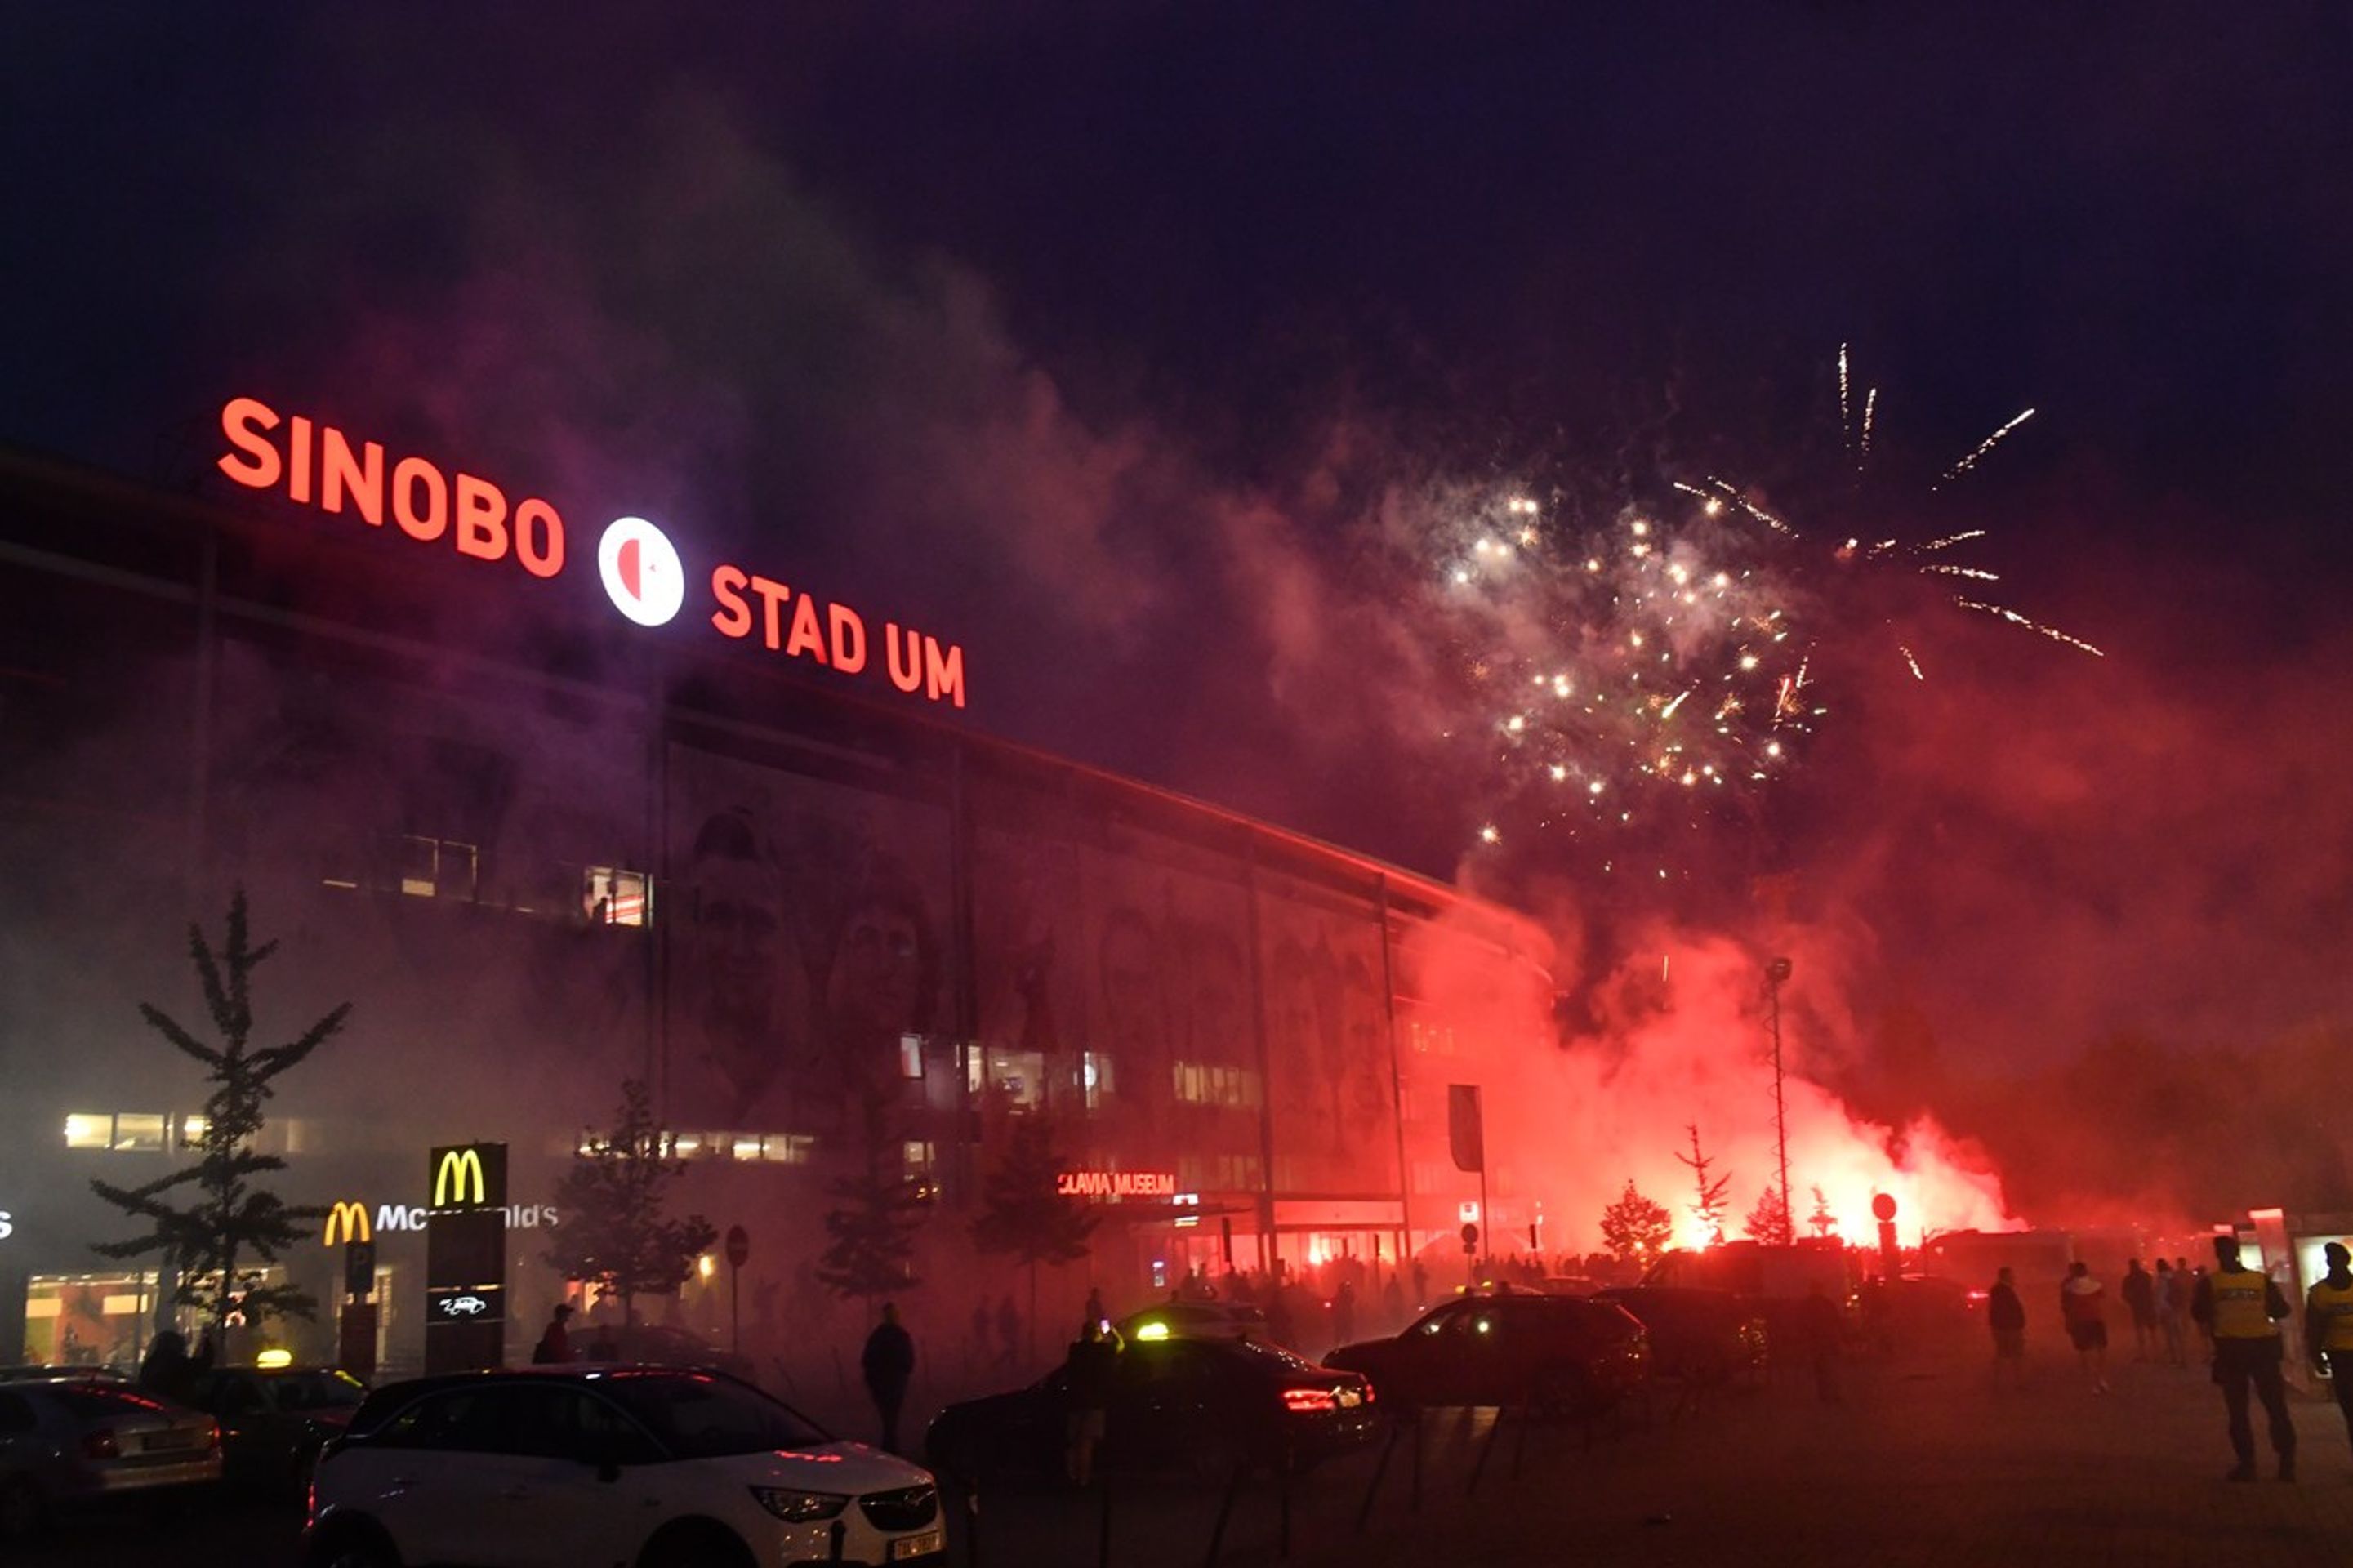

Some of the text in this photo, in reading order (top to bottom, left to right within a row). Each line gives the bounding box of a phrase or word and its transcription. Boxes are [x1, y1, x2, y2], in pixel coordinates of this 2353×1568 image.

[218, 397, 966, 708] SINOBO STADUM
[1113, 1173, 1174, 1195] MUSEUM
